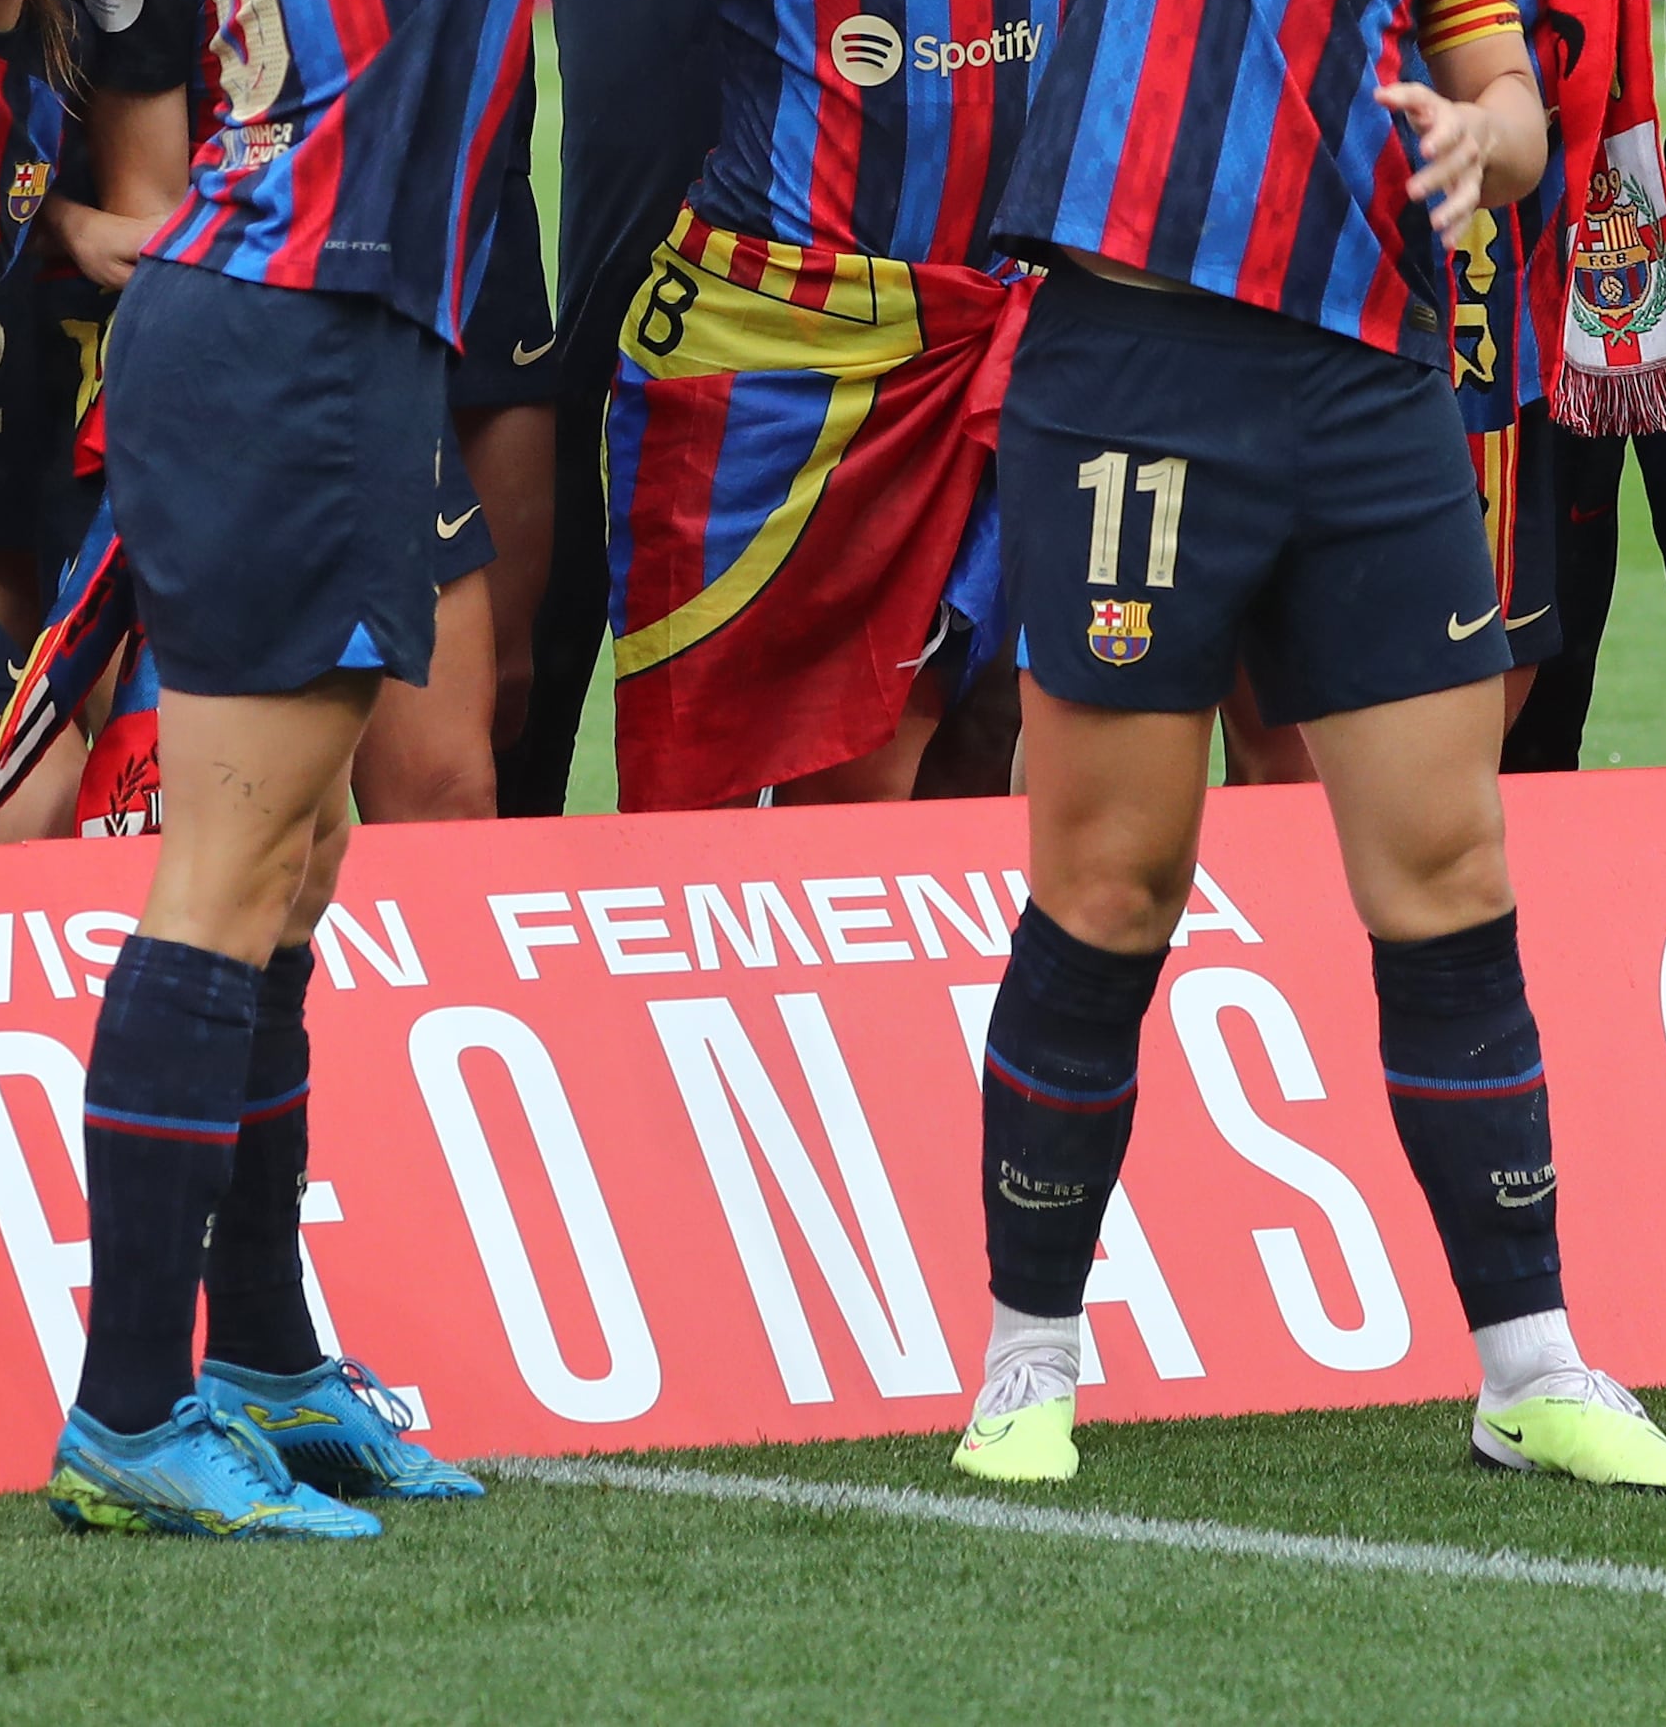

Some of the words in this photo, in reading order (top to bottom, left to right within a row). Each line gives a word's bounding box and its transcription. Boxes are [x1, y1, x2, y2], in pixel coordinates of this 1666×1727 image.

[913, 21, 1044, 78] Spotify
[637, 259, 699, 357] B
[1078, 451, 1189, 589] 11
[1107, 627, 1133, 636] FCB
[487, 862, 1264, 980] FEMENA
[999, 1159, 1085, 1196] CULERS
